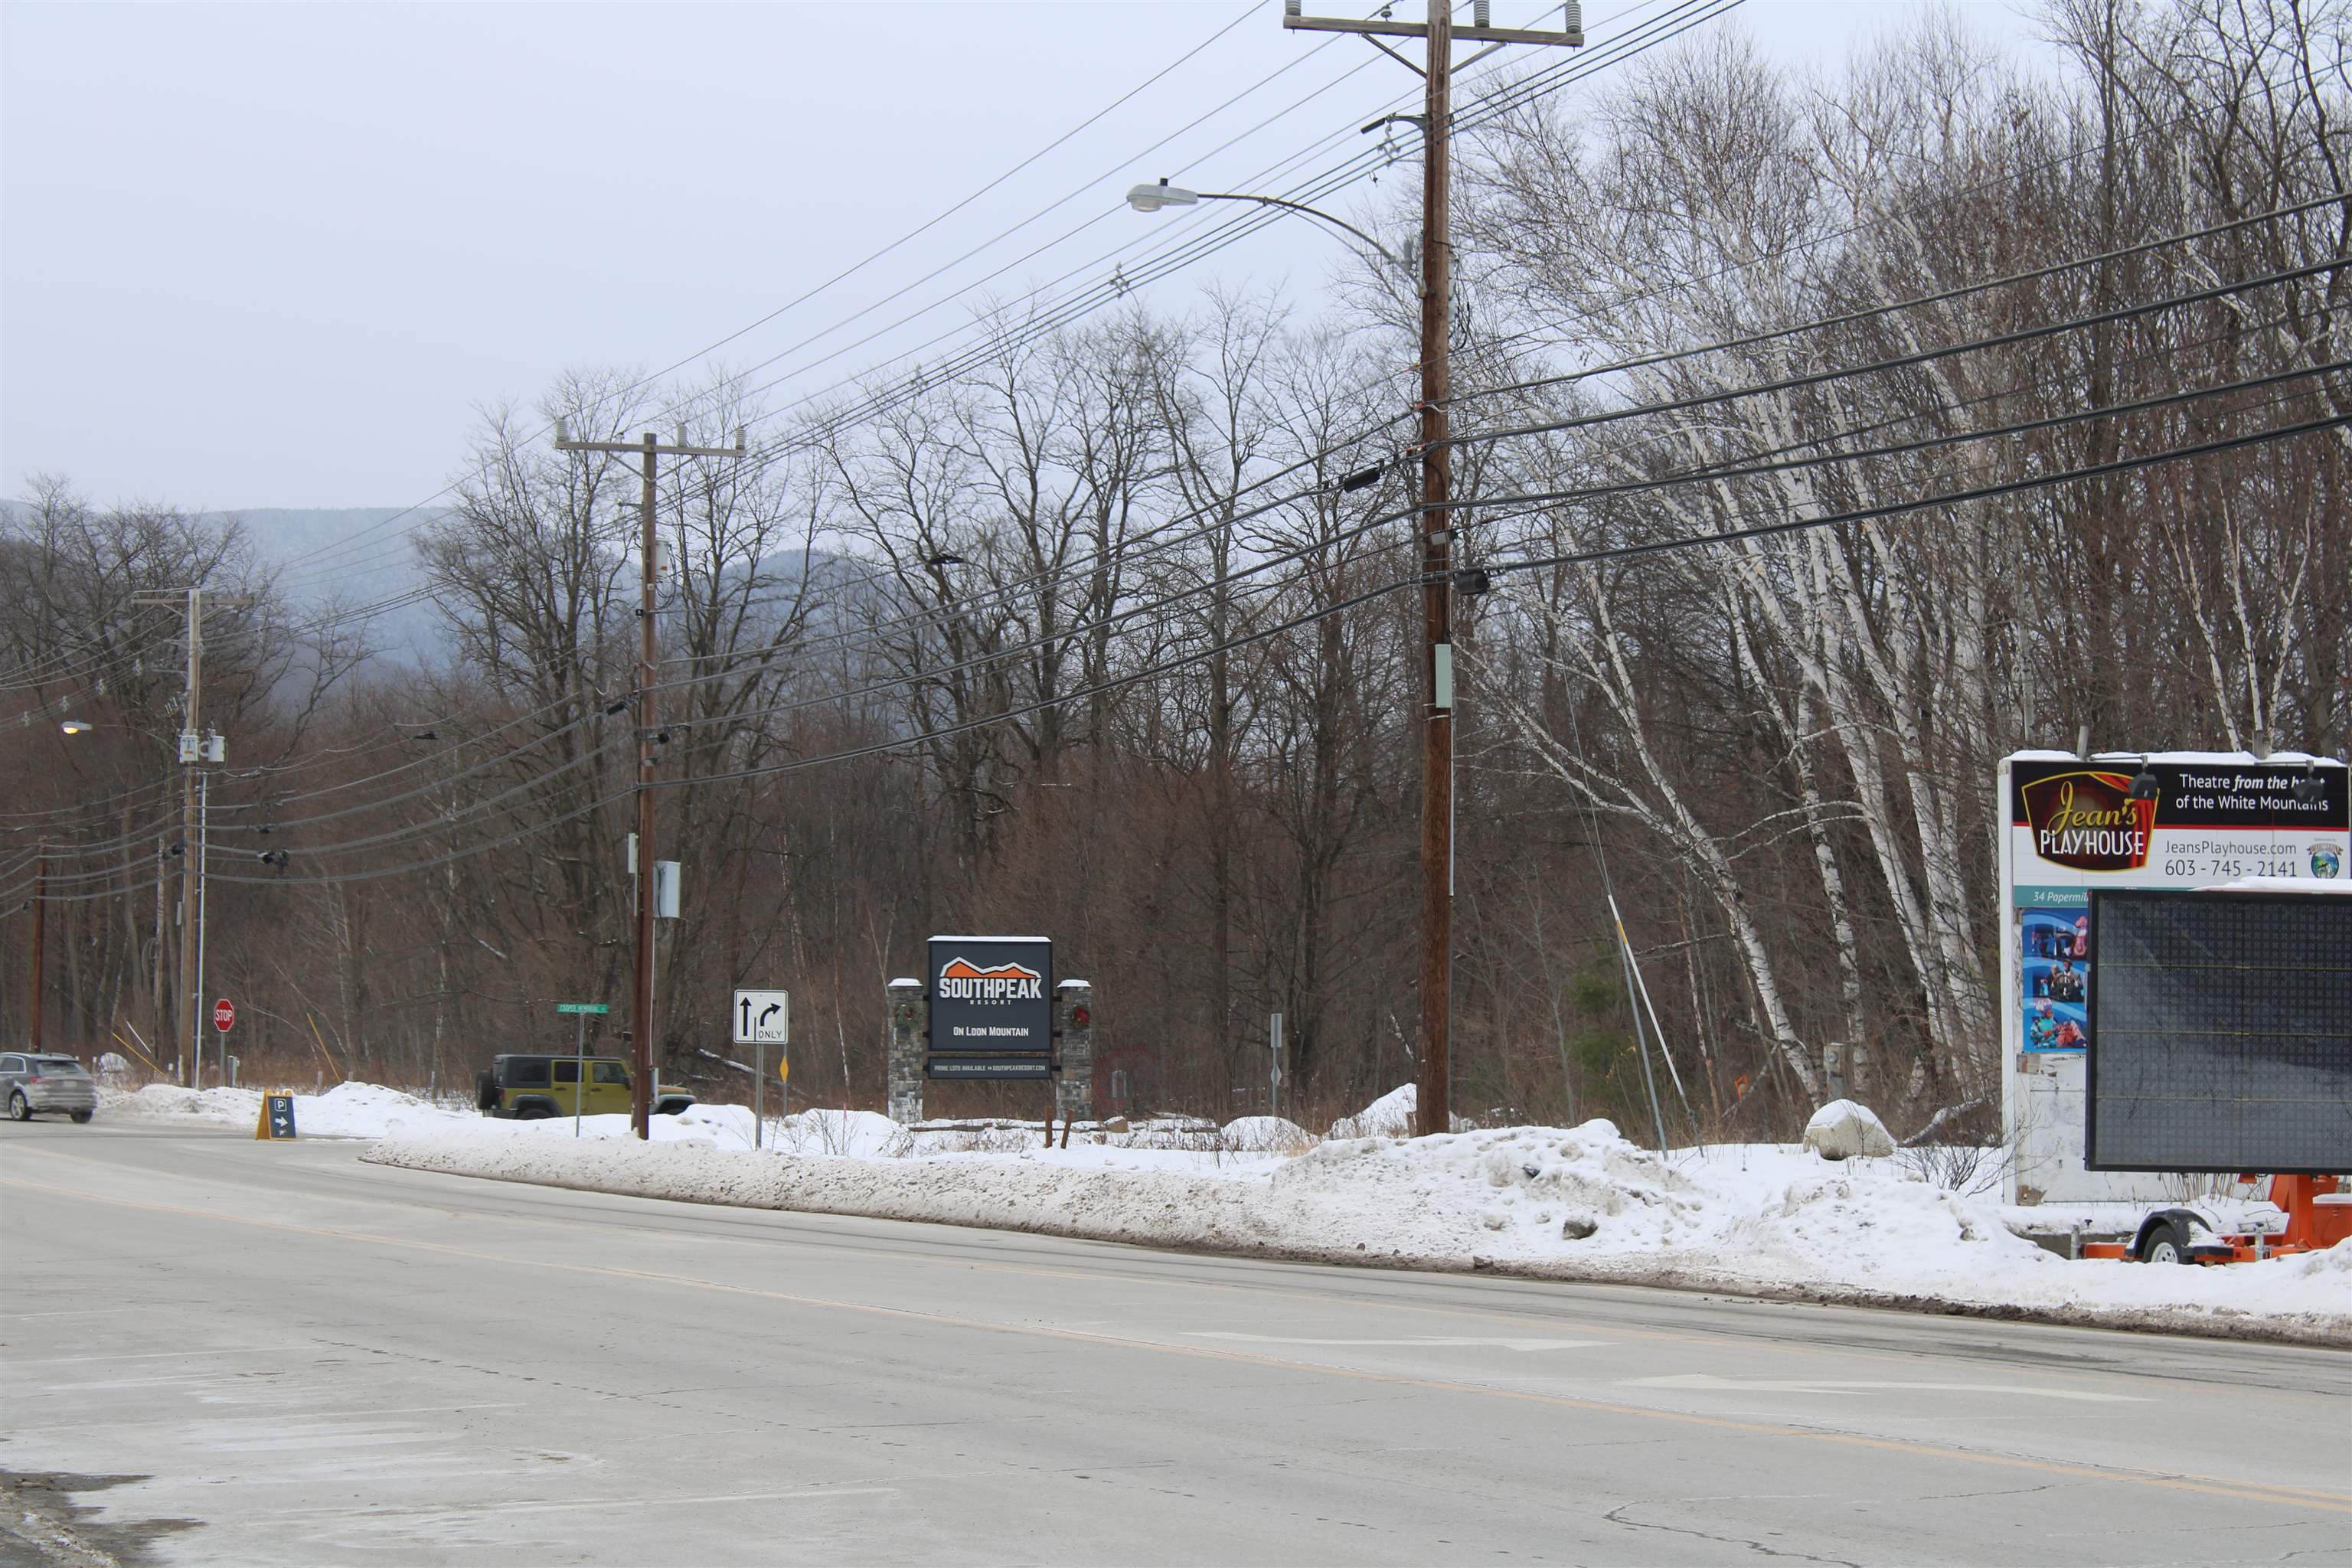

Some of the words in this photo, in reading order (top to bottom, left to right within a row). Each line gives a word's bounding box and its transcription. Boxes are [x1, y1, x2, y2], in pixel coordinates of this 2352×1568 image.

[2179, 773, 2230, 789] Theatre
[2232, 775, 2264, 792] from
[2267, 776, 2288, 789] the
[2047, 780, 2137, 836] Jean's
[2175, 795, 2190, 809] of
[2192, 795, 2214, 809] the
[2217, 795, 2256, 809] White
[2040, 829, 2144, 856] PLAYHOUSE
[2164, 840, 2297, 857] JeansPlayhouse.com
[2165, 859, 2195, 876] 603
[2211, 860, 2241, 876] 745
[2257, 861, 2297, 877] 2141
[2034, 891, 2045, 902] 34
[939, 978, 1042, 998] SOUTHPEAK
[215, 1009, 233, 1021] STOP
[758, 1031, 782, 1039] ONLY
[277, 1100, 285, 1109] P
